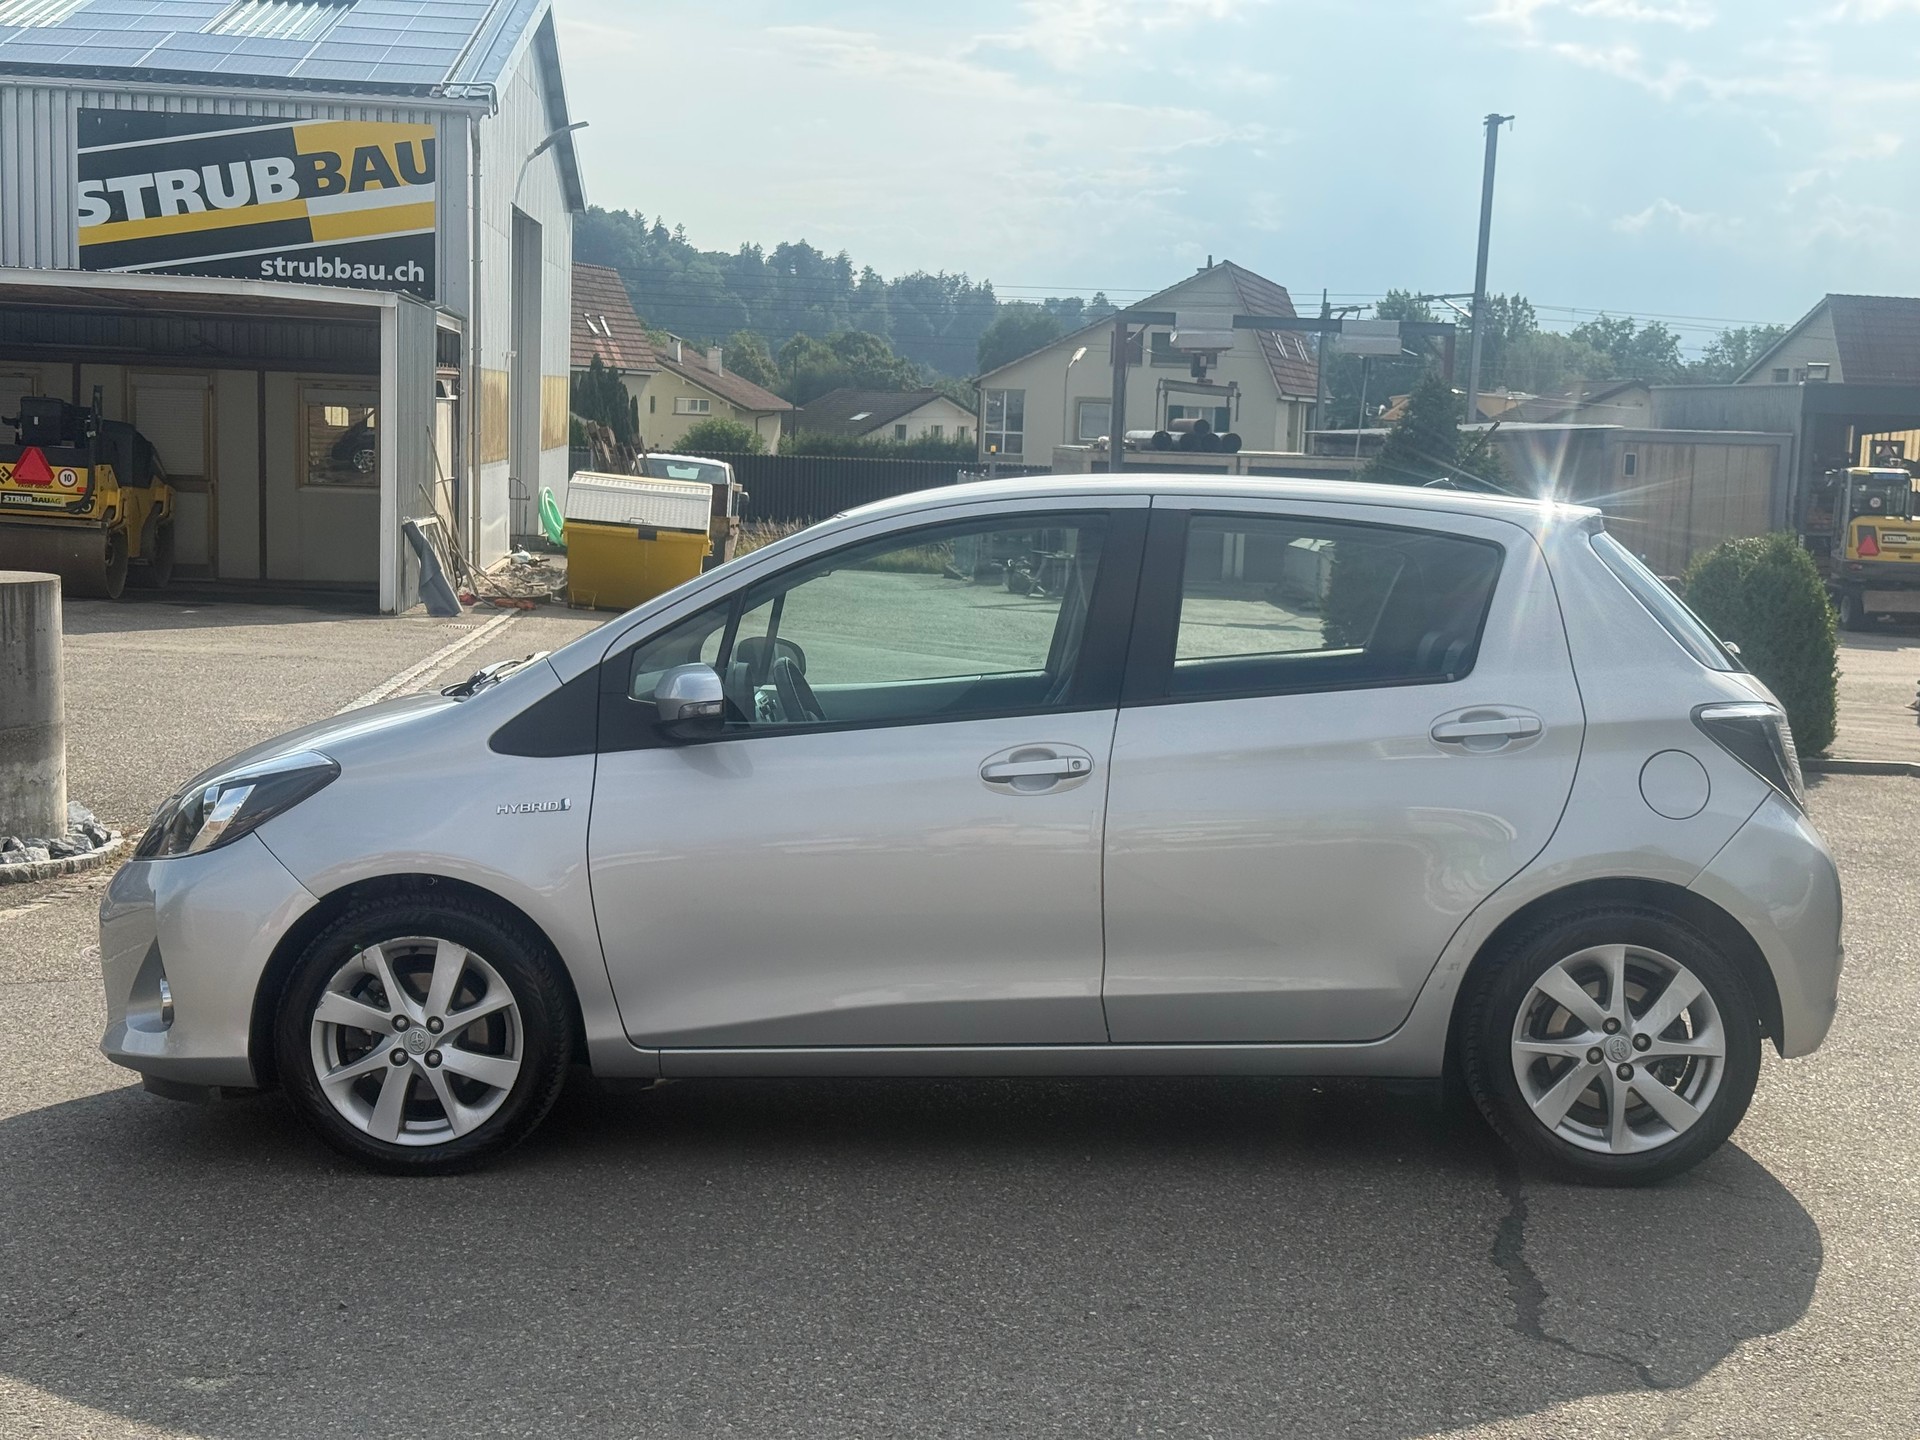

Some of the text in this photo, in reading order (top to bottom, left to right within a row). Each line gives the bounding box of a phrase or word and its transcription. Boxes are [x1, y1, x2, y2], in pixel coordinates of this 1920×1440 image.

[78, 138, 435, 227] STRUBBAU
[260, 256, 425, 282] strubbau.ch
[64, 473, 72, 482] 10
[496, 801, 559, 814] HYBRID
